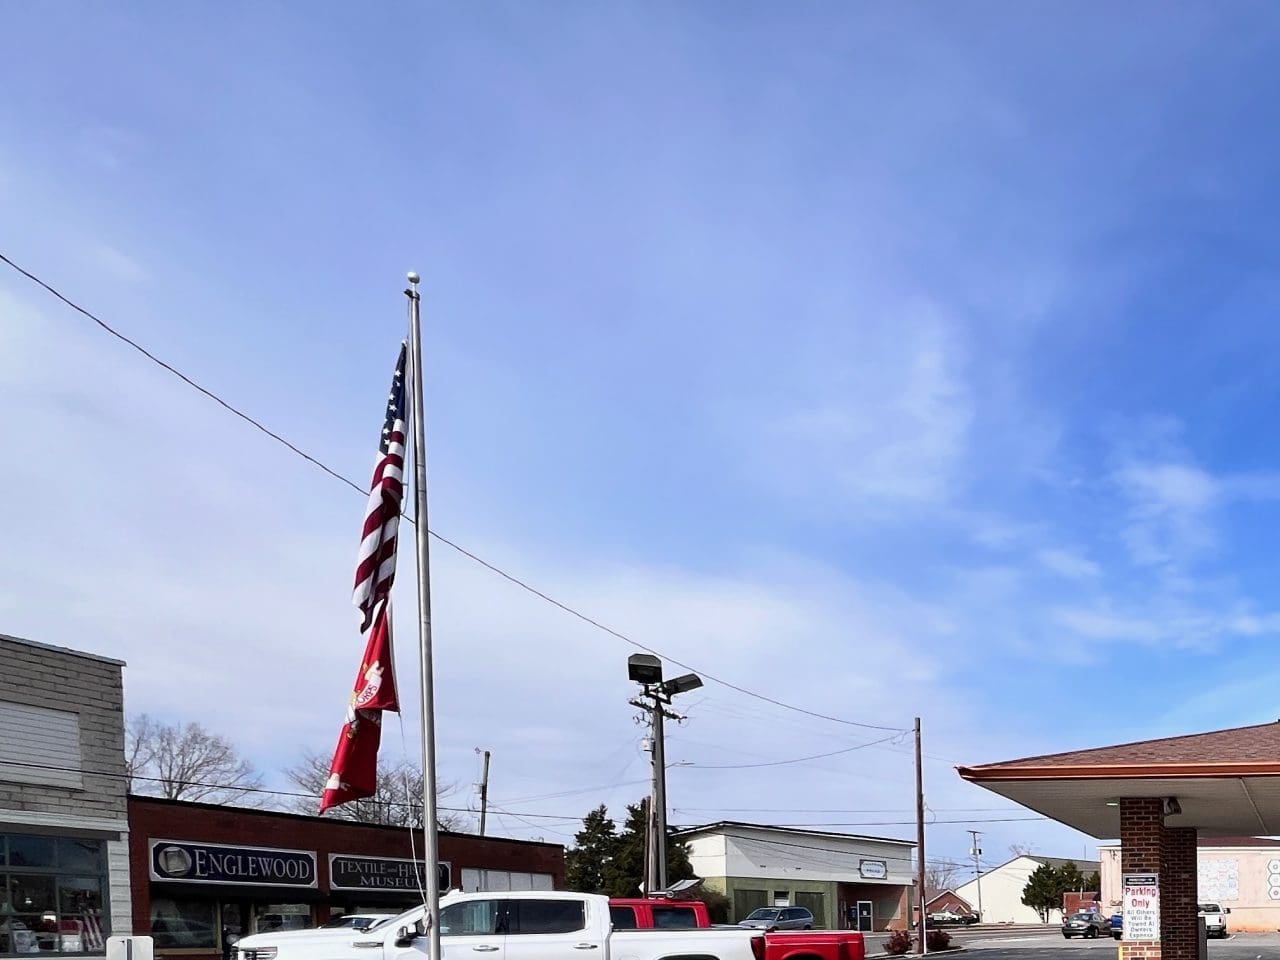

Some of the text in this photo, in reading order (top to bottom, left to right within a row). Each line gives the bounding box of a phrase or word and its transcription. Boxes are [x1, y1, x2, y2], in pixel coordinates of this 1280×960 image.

[194, 849, 310, 879] ENGLEWOOD
[337, 860, 387, 874] TEXTILE
[398, 863, 445, 878] HISTY
[1125, 887, 1156, 897] Parking
[1131, 899, 1150, 908] Only
